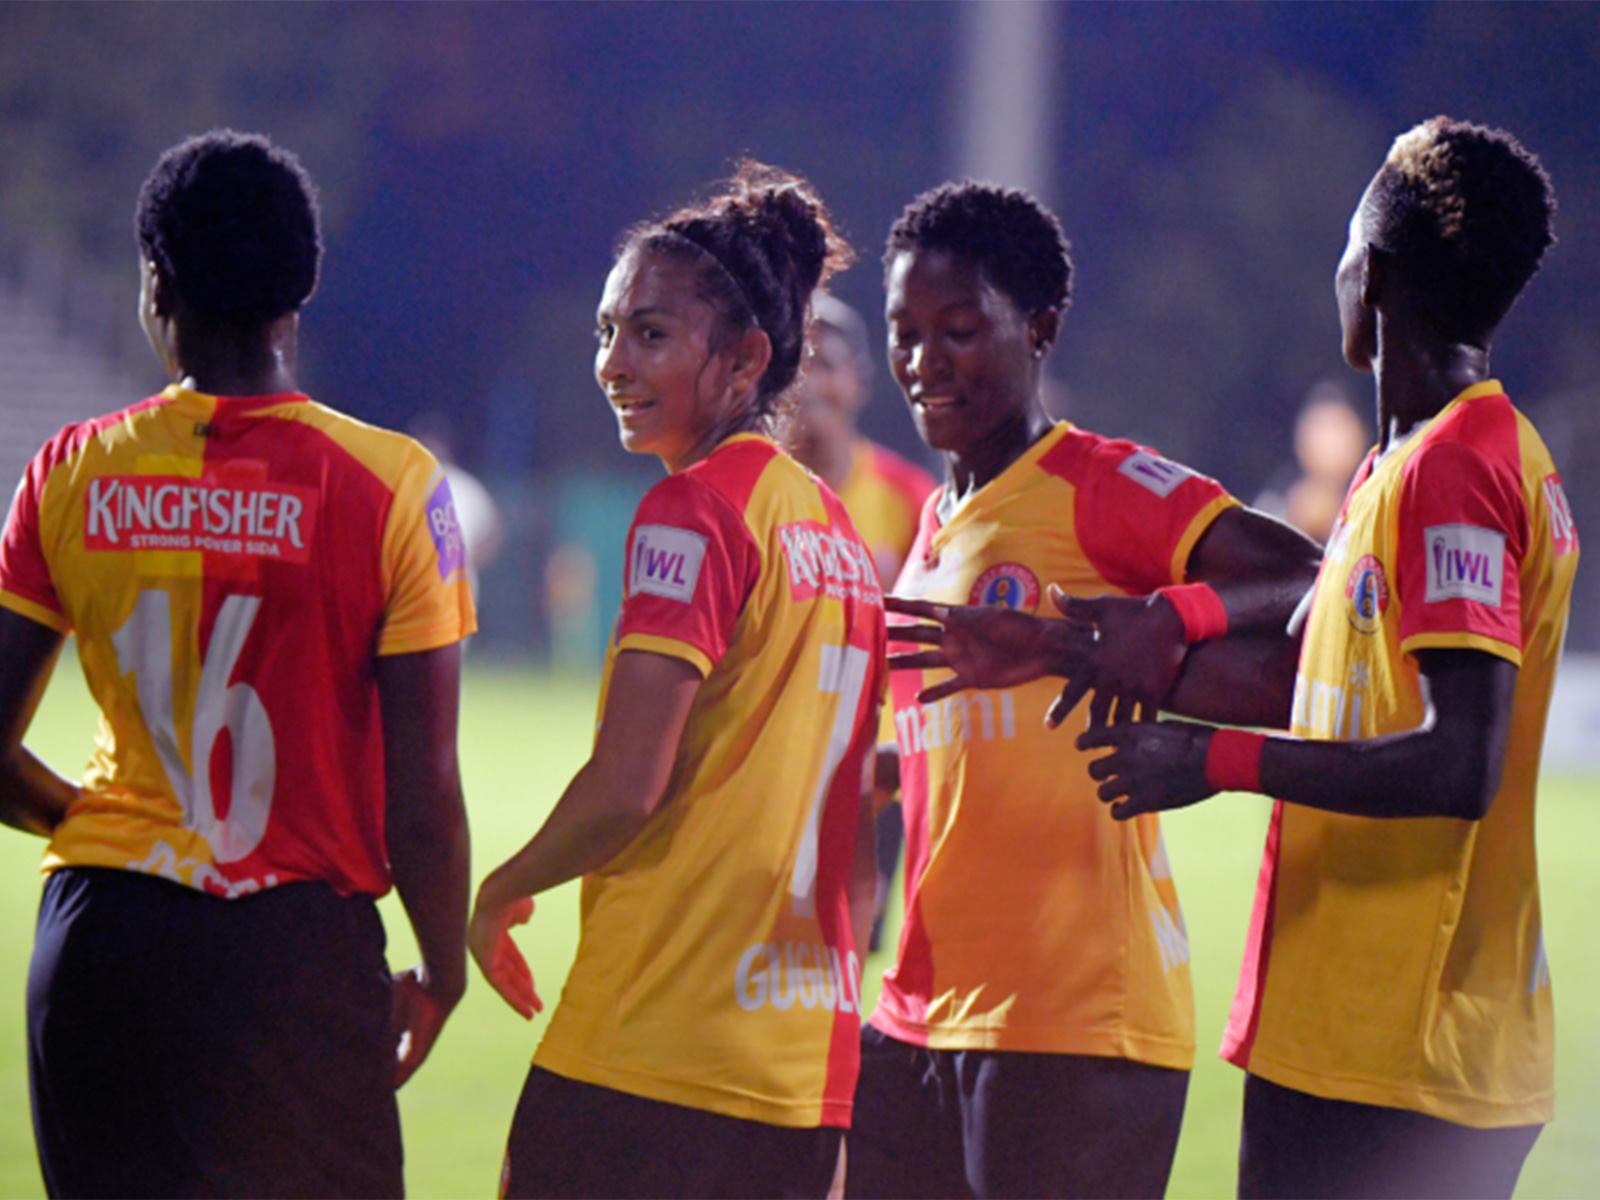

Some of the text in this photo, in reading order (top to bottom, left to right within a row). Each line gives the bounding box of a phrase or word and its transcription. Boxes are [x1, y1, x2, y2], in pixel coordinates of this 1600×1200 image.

[87, 478, 304, 548] KINGFISHER
[130, 534, 191, 548] STRONG
[245, 541, 280, 556] SIDA
[1447, 549, 1494, 588] IWL
[112, 589, 276, 864] 16
[792, 643, 869, 917] 7
